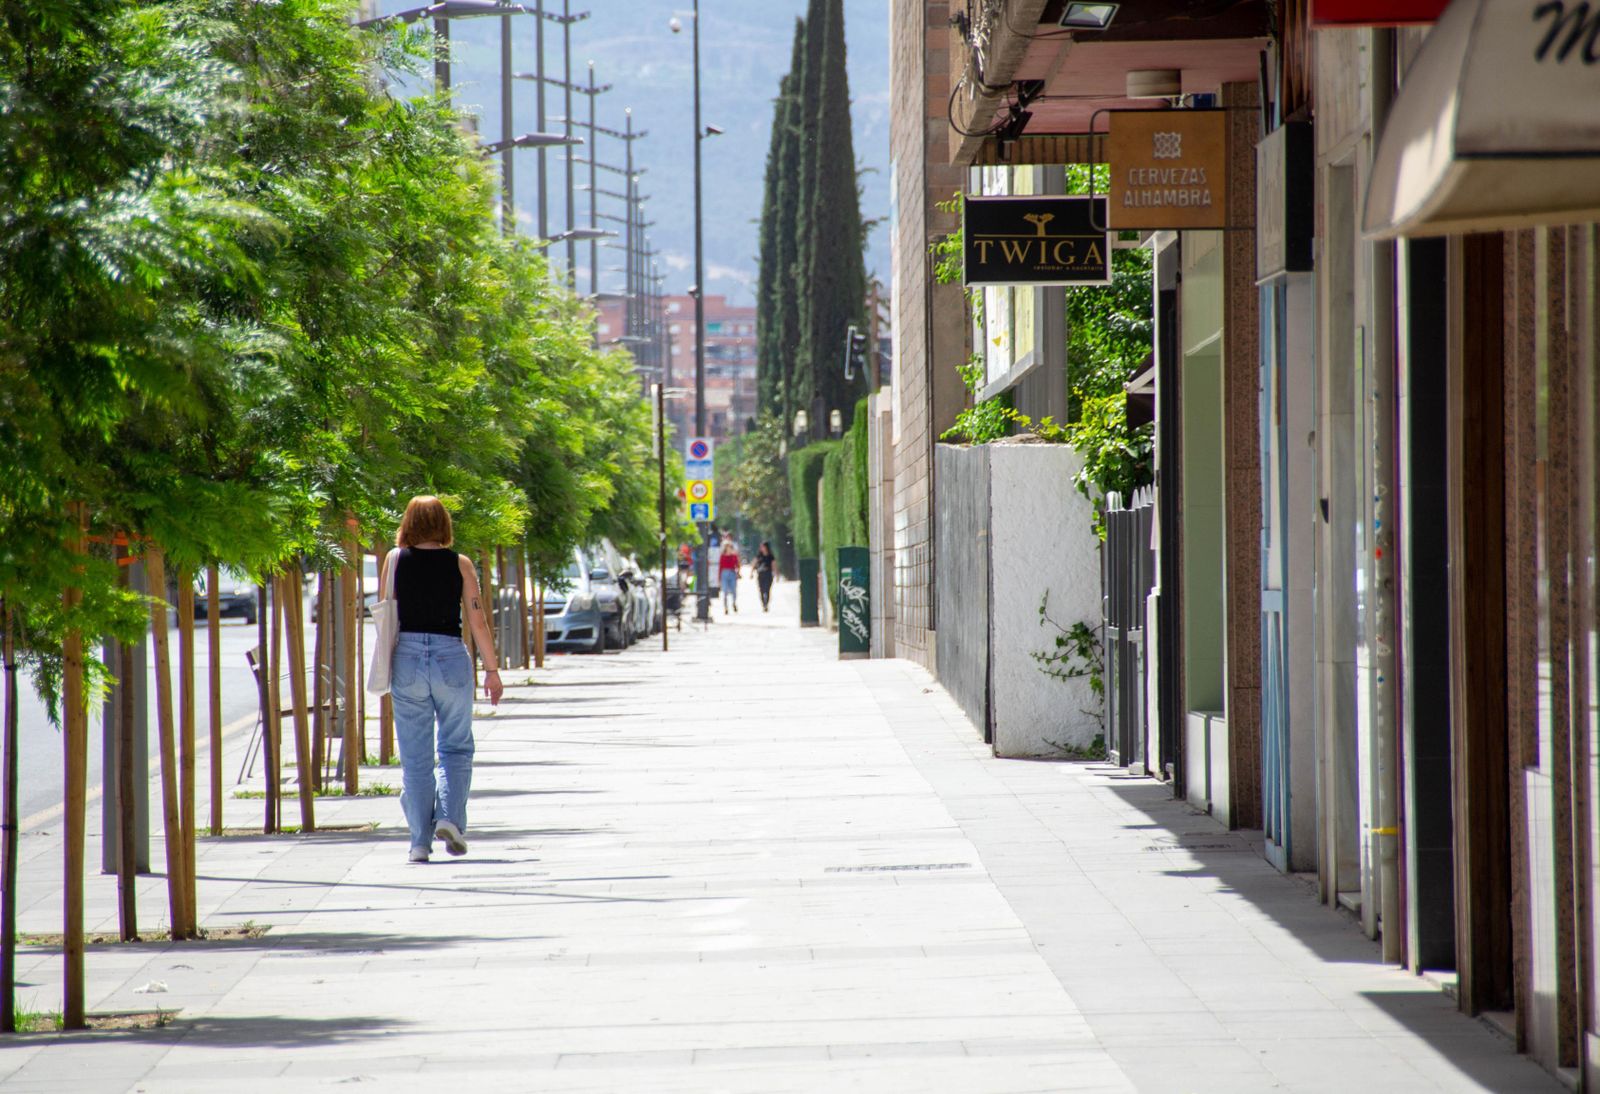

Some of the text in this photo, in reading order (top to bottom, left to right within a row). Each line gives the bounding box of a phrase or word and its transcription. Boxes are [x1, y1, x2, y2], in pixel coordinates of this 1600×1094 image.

[1129, 167, 1207, 185] CERVEZAS
[1124, 189, 1212, 207] ALHAMBRA
[973, 240, 1104, 265] TWIGA
